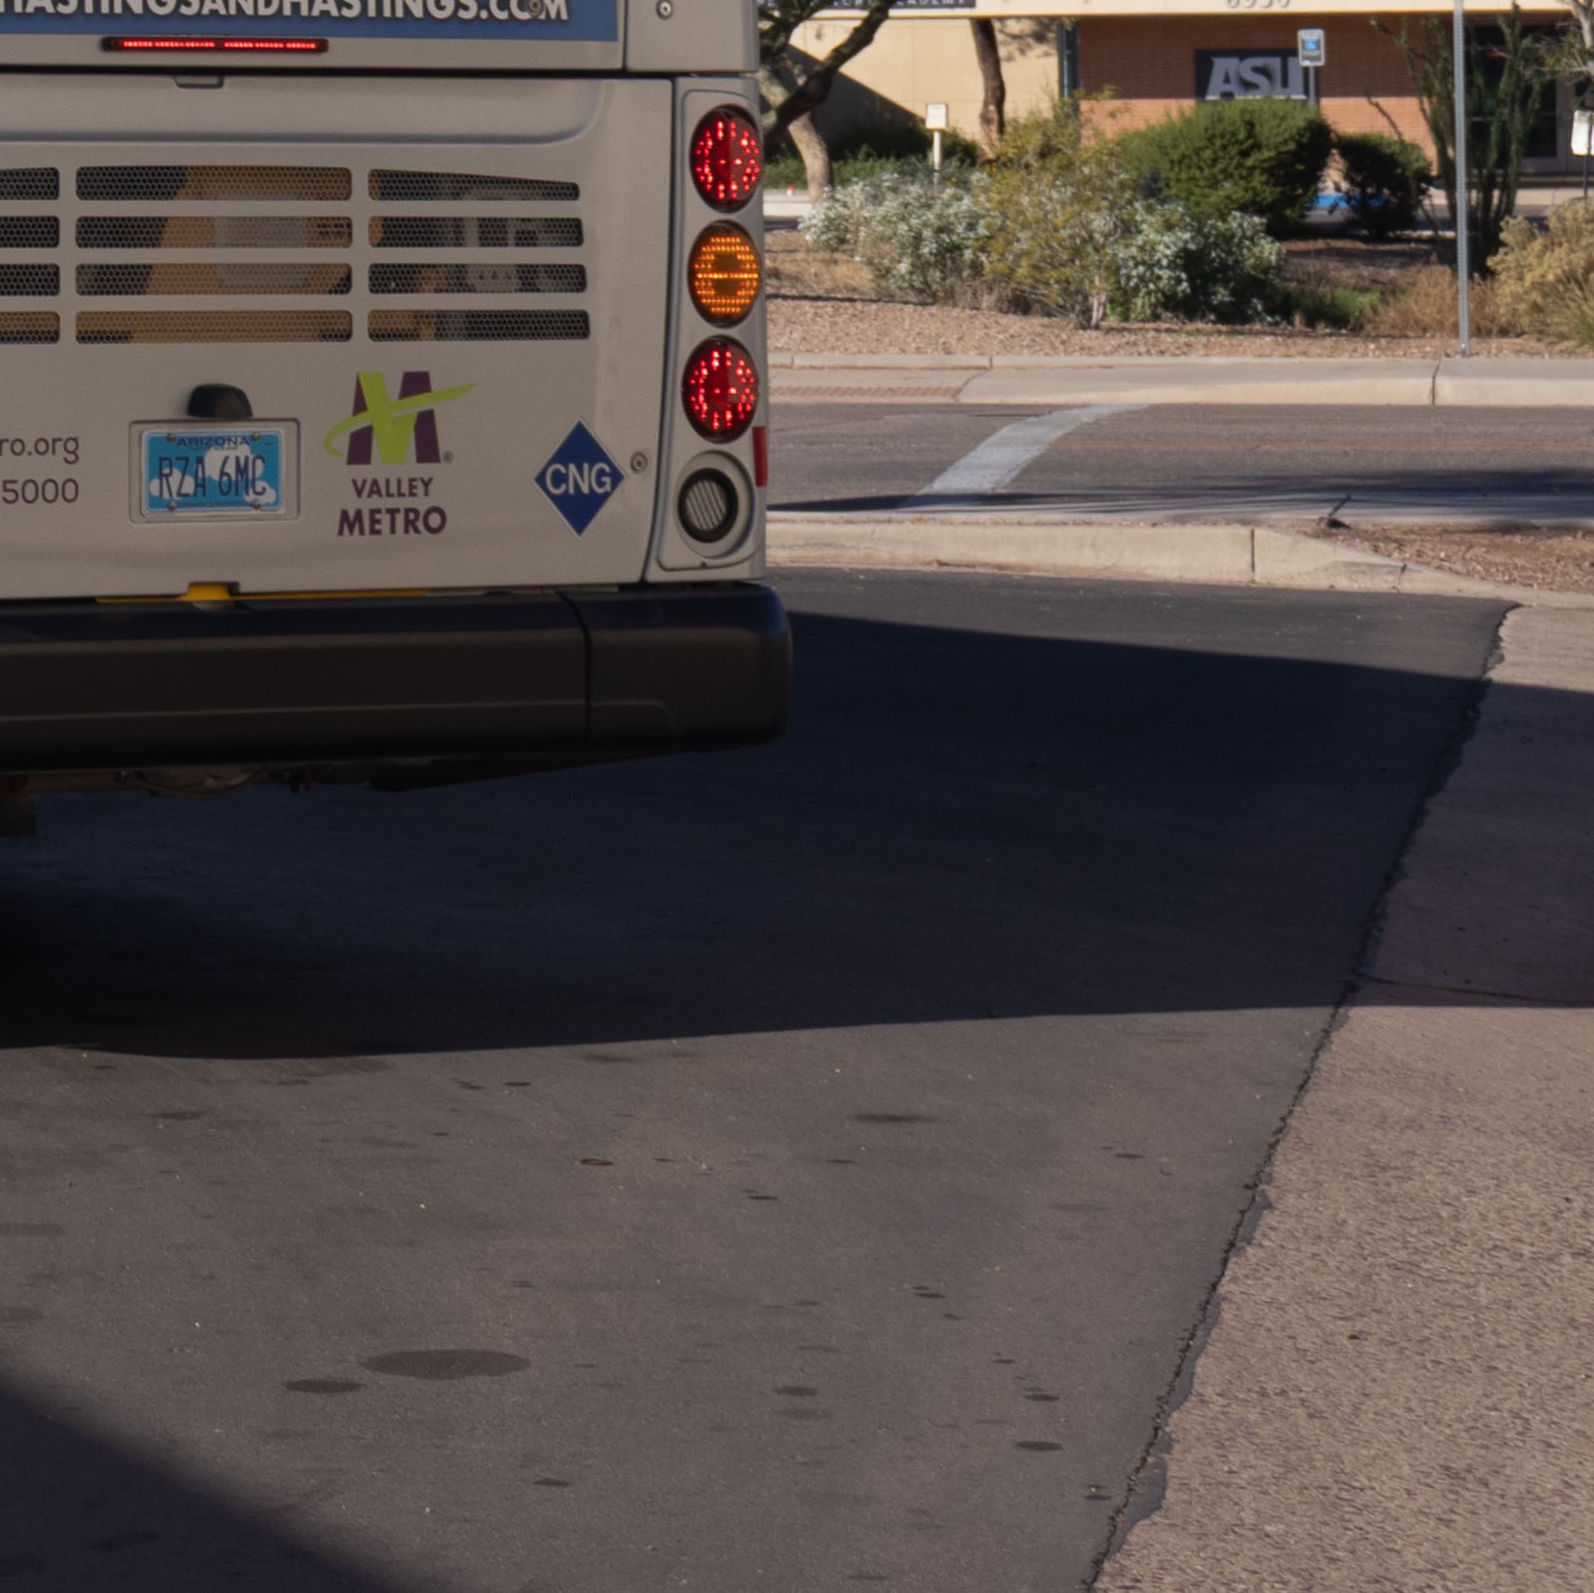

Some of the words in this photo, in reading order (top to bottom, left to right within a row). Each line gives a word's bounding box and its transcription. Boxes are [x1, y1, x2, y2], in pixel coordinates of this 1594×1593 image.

[1205, 56, 1308, 100] ASU
[177, 437, 250, 447] ARIZONA
[351, 477, 434, 499] VALLEY
[545, 462, 613, 495] CNG
[337, 505, 447, 537] METRO
